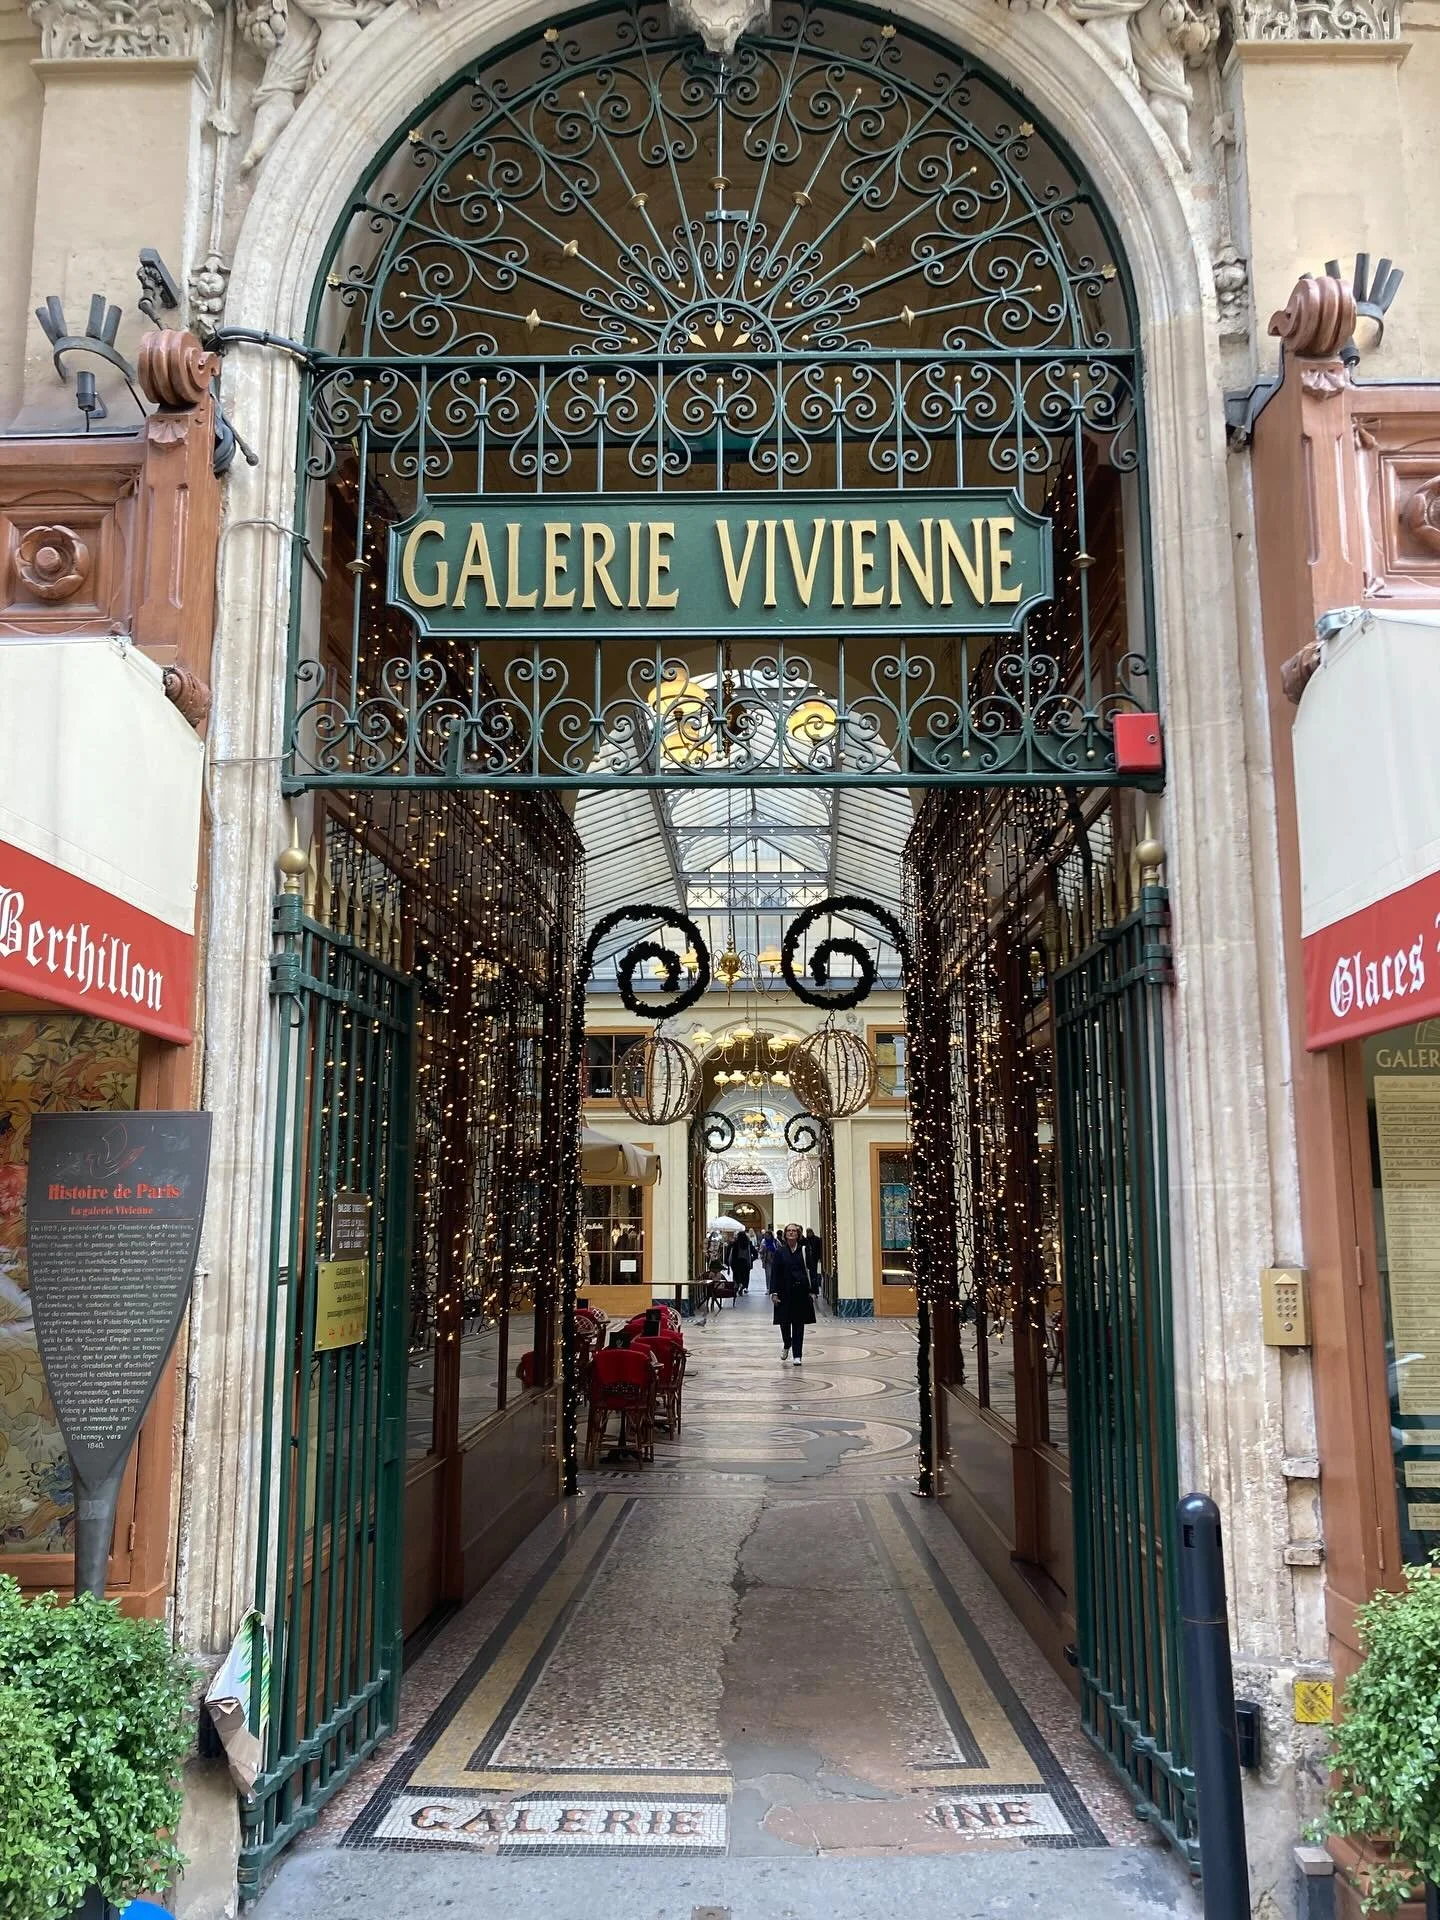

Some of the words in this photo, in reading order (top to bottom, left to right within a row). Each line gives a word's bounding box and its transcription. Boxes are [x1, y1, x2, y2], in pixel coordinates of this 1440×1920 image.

[402, 518, 679, 611] GALERIE
[715, 516, 1024, 610] VIVIENNE
[0, 886, 163, 1012] Berthillon
[1330, 933, 1425, 1018] Glaces
[48, 1184, 109, 1200] Histoire
[112, 1183, 132, 1199] de
[137, 1183, 182, 1199] Paris
[409, 1804, 704, 1836] GALERIE
